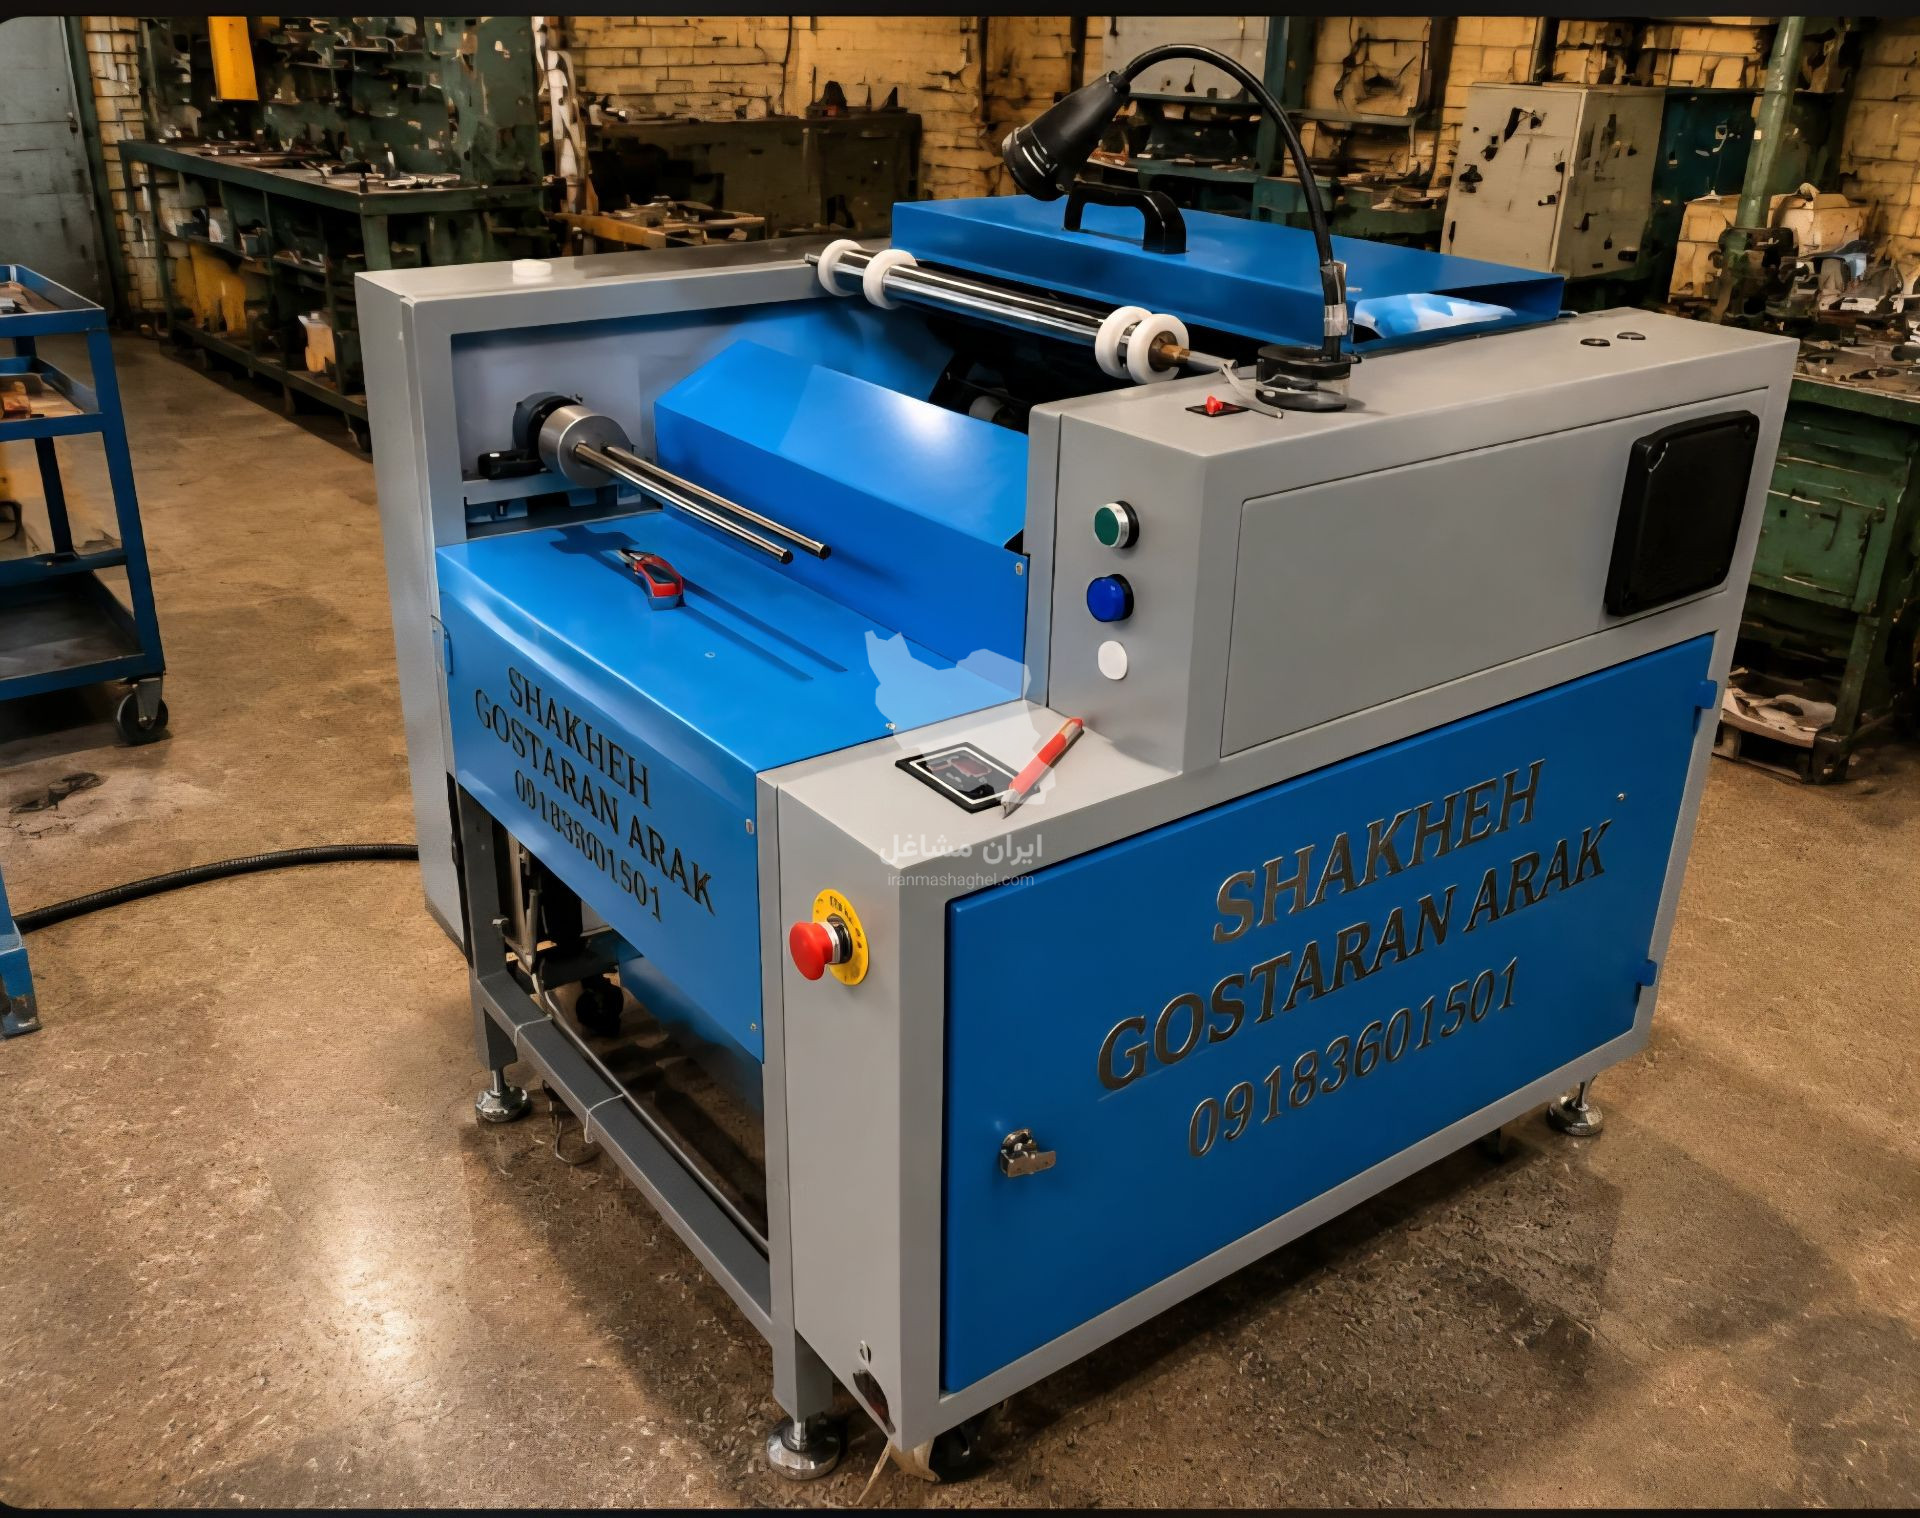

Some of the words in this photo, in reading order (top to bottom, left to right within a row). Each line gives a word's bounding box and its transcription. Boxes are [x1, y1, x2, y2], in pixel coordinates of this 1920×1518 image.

[475, 689, 620, 835] GOSTARAN
[628, 815, 716, 917] ARAK
[508, 667, 652, 810] SHAKHEH
[1213, 758, 1546, 945] SHAKHEH
[1097, 885, 1457, 1092] GOSTARAN
[1463, 819, 1613, 934] ARAK
[1188, 956, 1519, 1158] 09183601501
